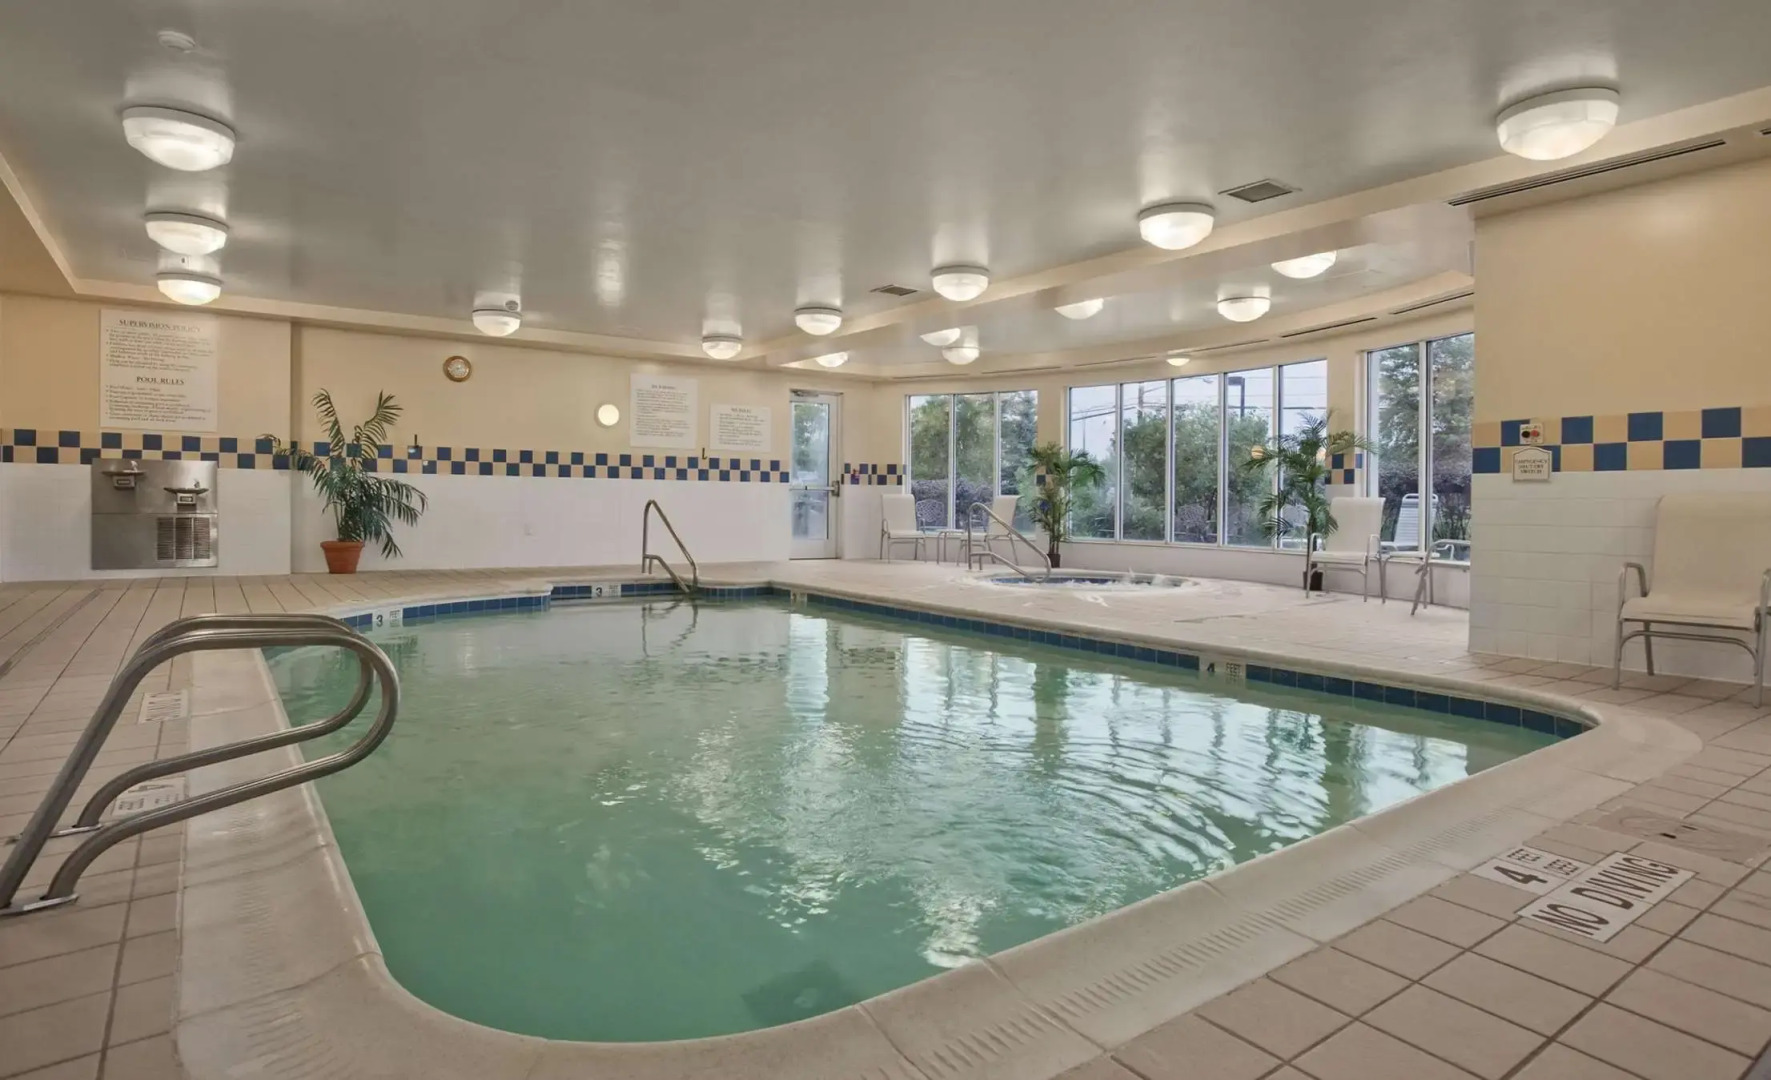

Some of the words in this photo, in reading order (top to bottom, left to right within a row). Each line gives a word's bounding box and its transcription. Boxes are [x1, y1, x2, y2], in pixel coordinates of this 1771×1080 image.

[119, 319, 171, 330] SUPERVISION
[136, 376, 158, 384] POOL
[159, 378, 185, 386] RULES
[376, 614, 383, 627] 3
[1493, 866, 1548, 885] 4
[1570, 857, 1680, 910] DIVING
[1531, 903, 1610, 936] NO
